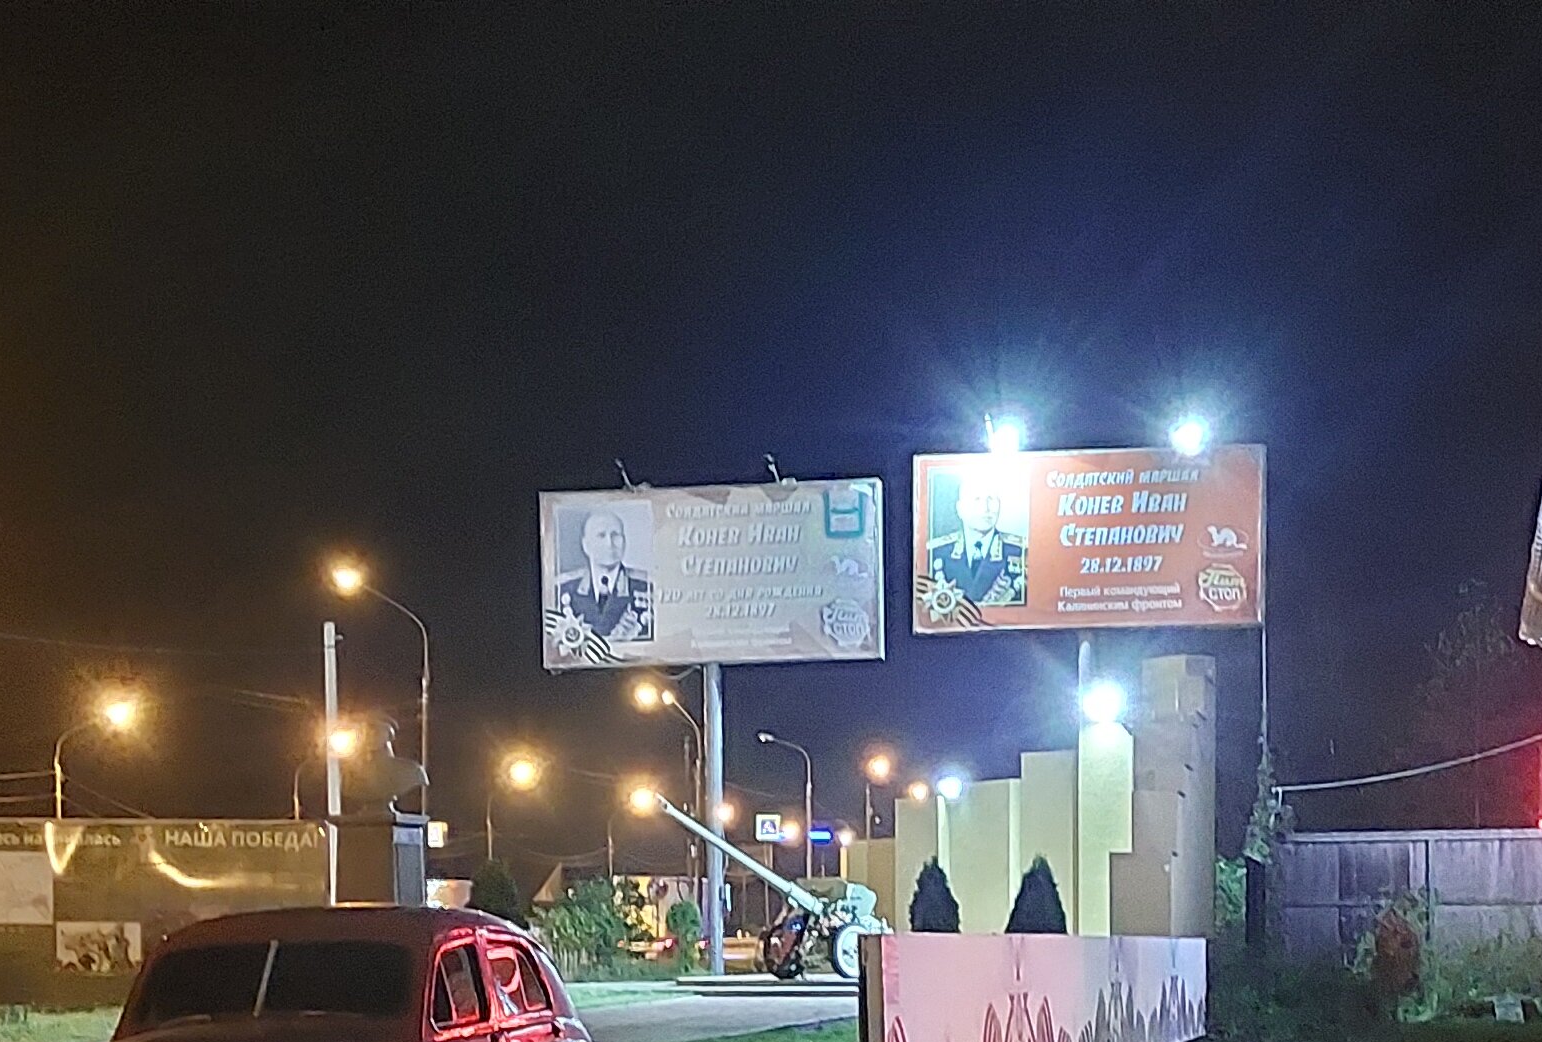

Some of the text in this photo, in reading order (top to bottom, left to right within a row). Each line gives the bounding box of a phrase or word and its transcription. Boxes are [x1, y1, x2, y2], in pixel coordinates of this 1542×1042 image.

[1080, 555, 1163, 574] 28.12.1897
[164, 829, 319, 853] НАША ПОБЕДА!
